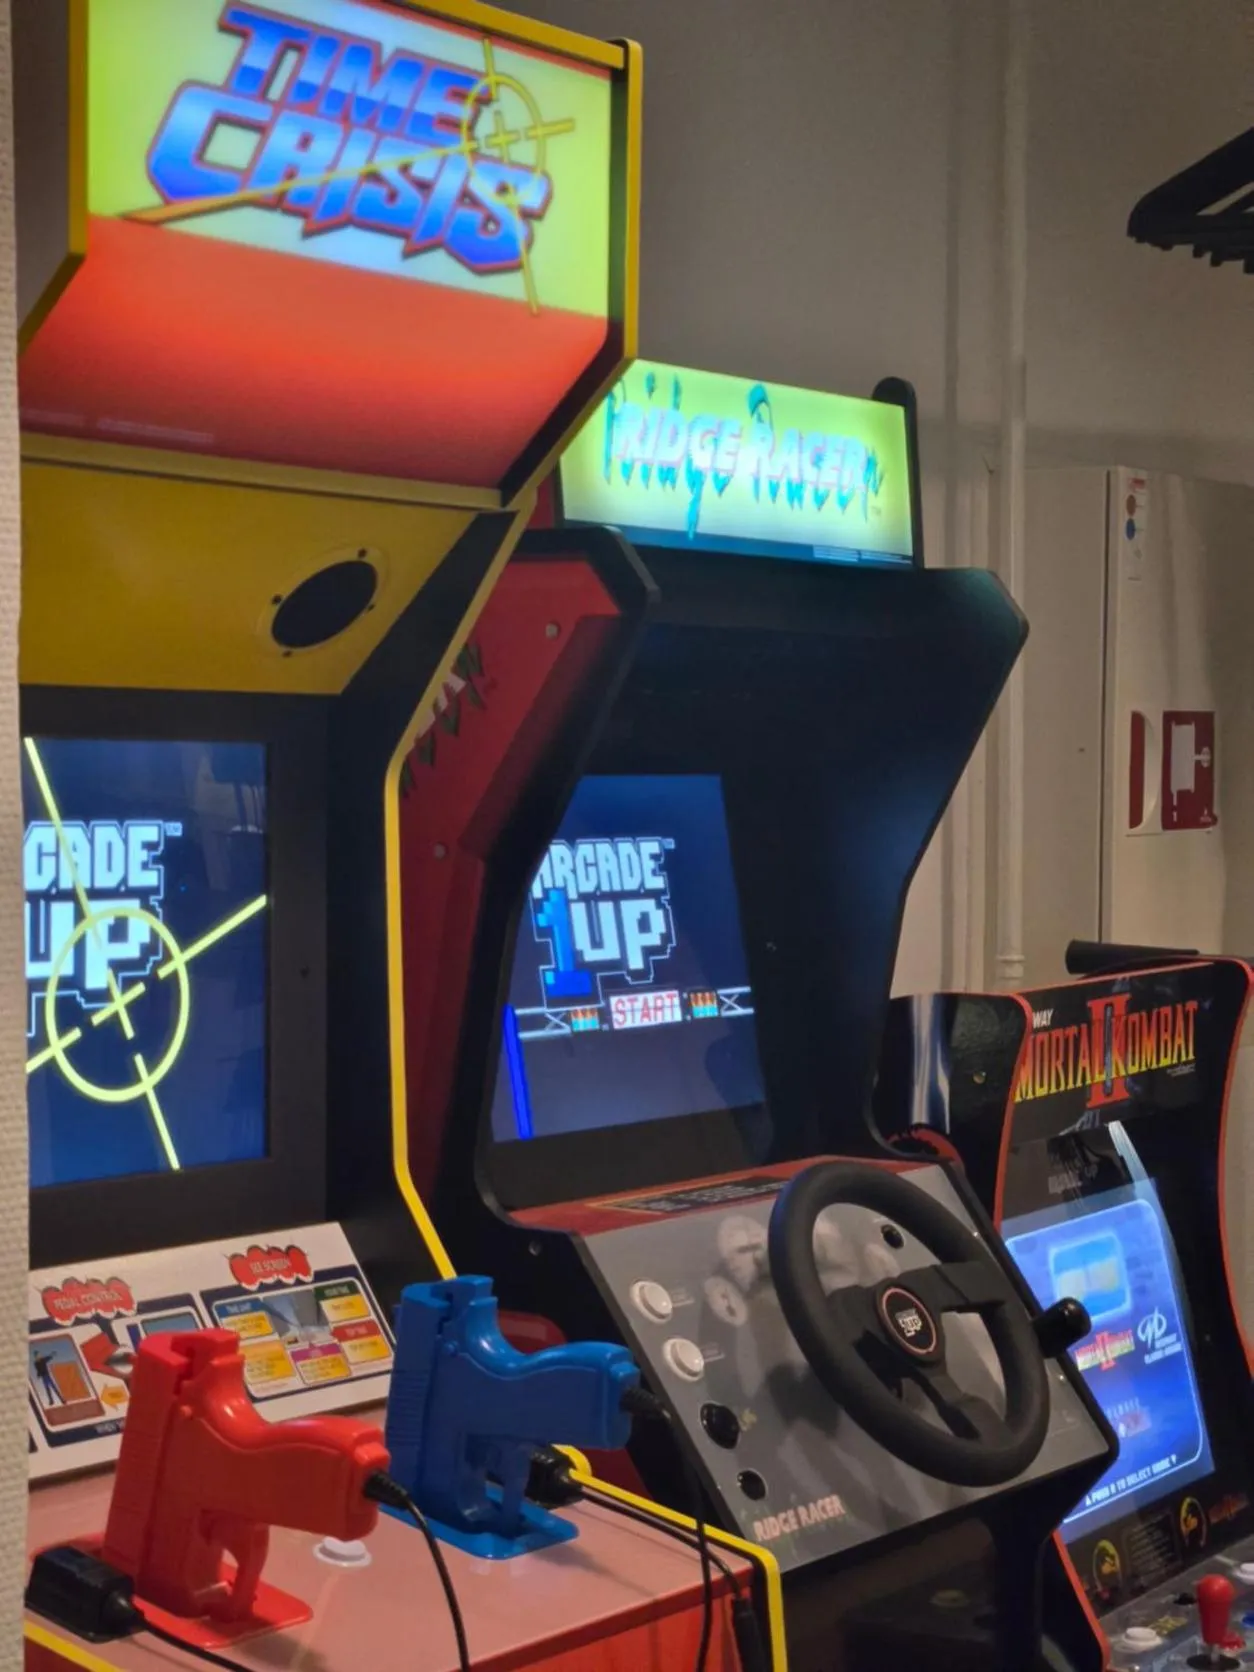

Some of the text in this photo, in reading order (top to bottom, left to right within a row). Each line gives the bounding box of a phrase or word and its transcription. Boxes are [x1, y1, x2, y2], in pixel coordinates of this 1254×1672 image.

[217, 0, 492, 147] TIME
[146, 80, 553, 276] CRISIS
[606, 400, 874, 505] RIDGE RACER
[23, 822, 161, 892] CADE
[531, 839, 665, 898] ARCADE
[25, 899, 151, 989] UP
[613, 992, 679, 1027] START
[1032, 1008, 1054, 1029] WAY
[1015, 1020, 1107, 1103] MORTAL
[1110, 1000, 1199, 1080] KOMBAT
[753, 1494, 846, 1541] RIDGE RACER
